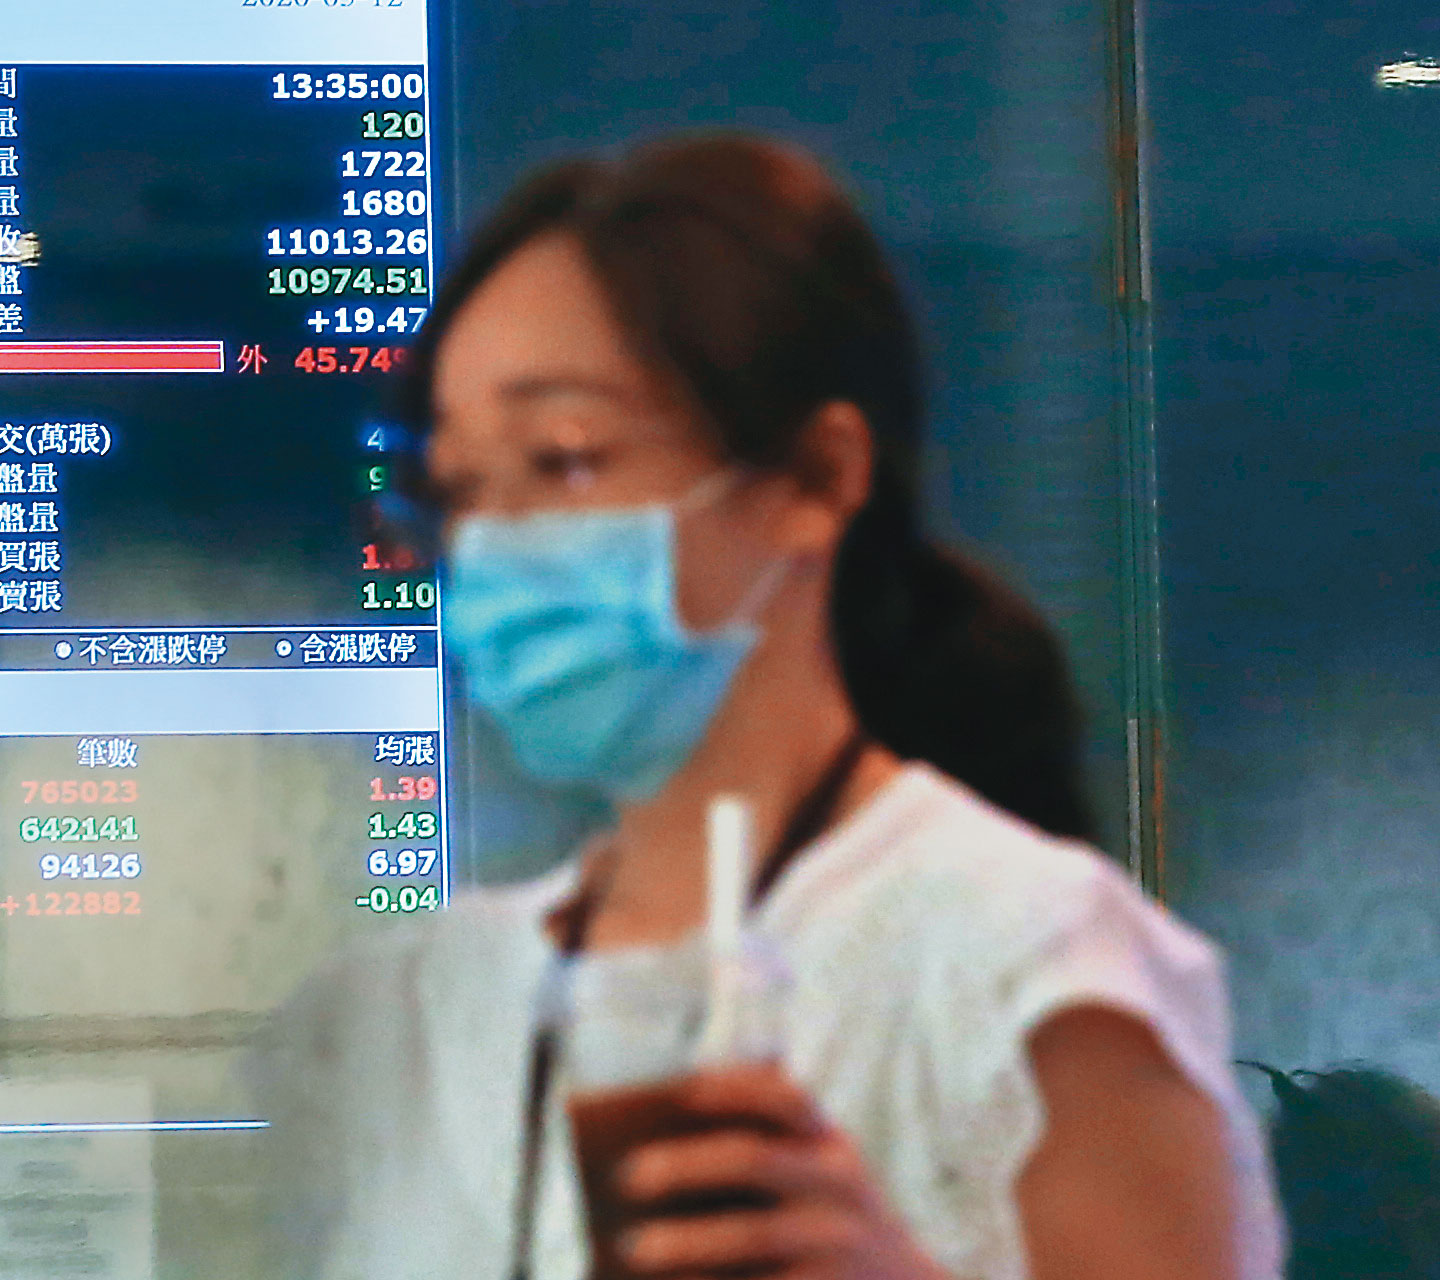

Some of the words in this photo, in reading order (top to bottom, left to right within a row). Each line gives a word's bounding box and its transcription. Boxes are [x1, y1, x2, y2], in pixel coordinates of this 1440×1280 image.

[272, 73, 423, 99] 13:35:00
[362, 112, 424, 138] 120
[341, 151, 425, 177] 1722
[342, 190, 426, 216] 1680
[267, 229, 427, 256] 11013.26
[268, 268, 427, 295] 10974.51
[308, 306, 427, 333] +19.47
[237, 344, 268, 375] 外
[363, 582, 435, 609] 1.10
[79, 635, 227, 665] 不含漲跌停
[299, 634, 417, 664] 含漲跌停
[78, 738, 137, 767] 筆數
[375, 736, 435, 765] 均張
[22, 781, 138, 804] 765023
[370, 777, 437, 801] 1.39
[20, 817, 139, 842] 642141
[369, 814, 437, 838] 1.43
[40, 854, 141, 879] 94126
[369, 850, 437, 875] 6.97
[0, 892, 141, 917] +122882
[356, 887, 438, 912] -0.04
